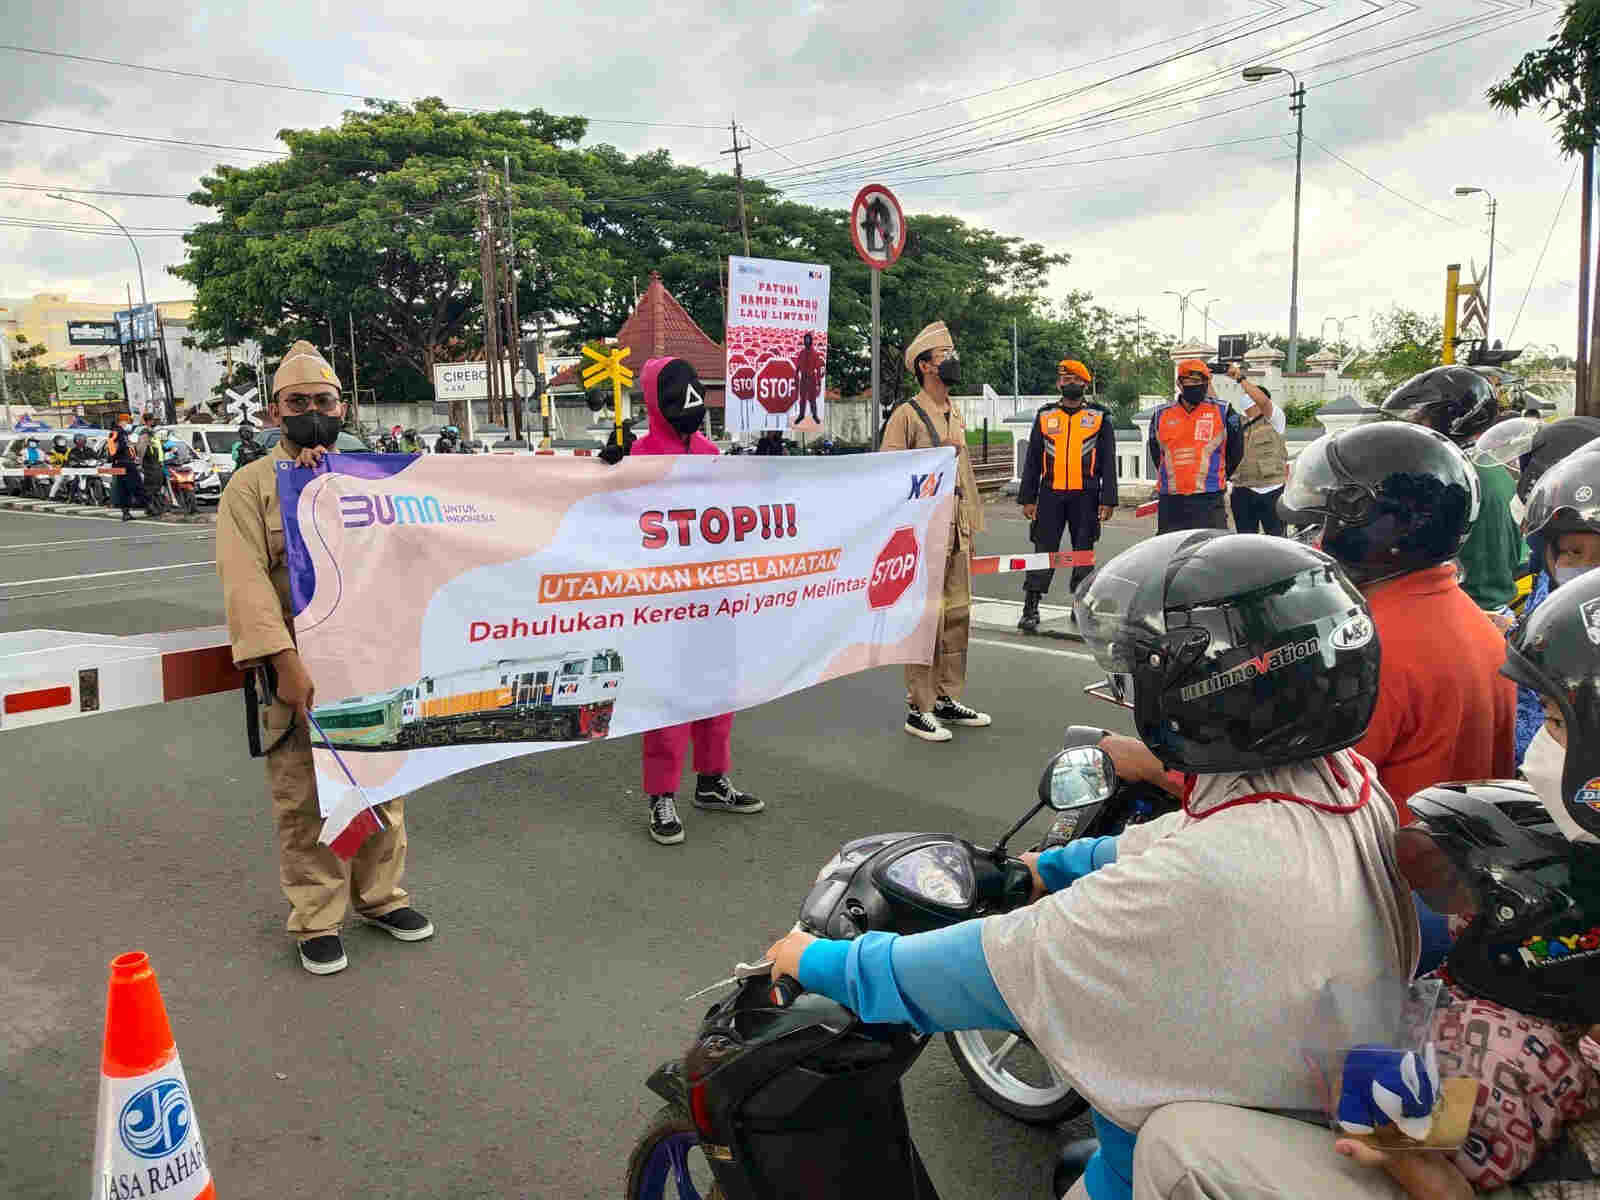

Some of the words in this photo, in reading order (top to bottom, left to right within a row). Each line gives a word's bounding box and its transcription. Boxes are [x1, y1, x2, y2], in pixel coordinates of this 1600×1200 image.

[543, 567, 692, 599] UTAMAKAN
[698, 549, 841, 586] KESELAMATAN
[871, 553, 916, 587] STOP
[469, 611, 624, 643] Dahulukan
[633, 601, 710, 626] Kereta
[715, 592, 750, 621] Api
[754, 590, 798, 613] yang
[802, 576, 867, 600] Melintas
